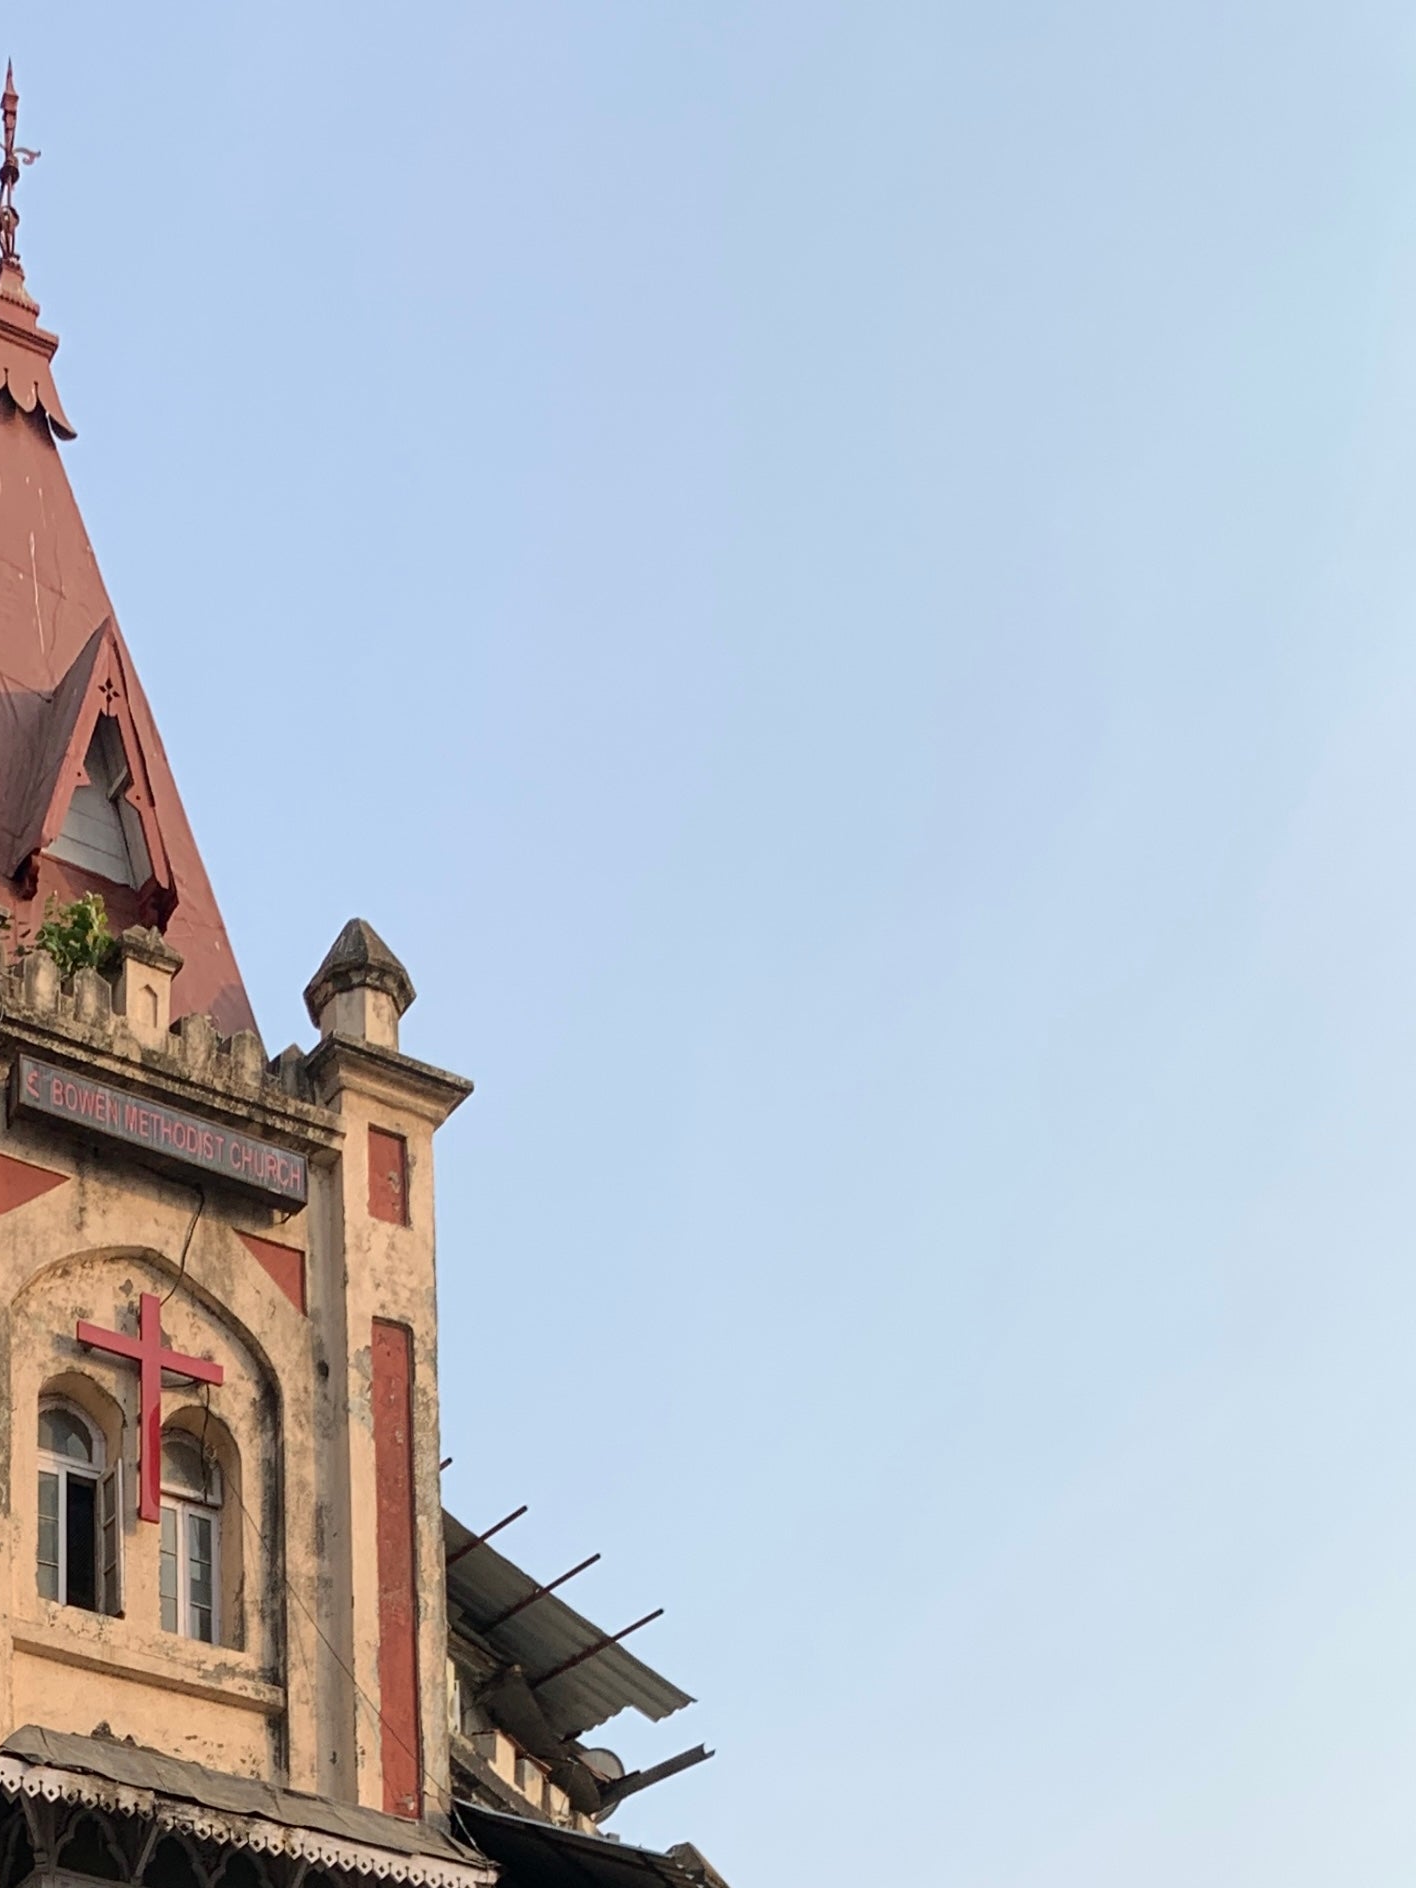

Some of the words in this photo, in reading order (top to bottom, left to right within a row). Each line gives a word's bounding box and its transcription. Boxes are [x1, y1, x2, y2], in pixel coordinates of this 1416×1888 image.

[51, 1078, 119, 1126] BOWEN
[124, 1105, 225, 1160] METHODIST
[230, 1142, 302, 1191] CHURCH
